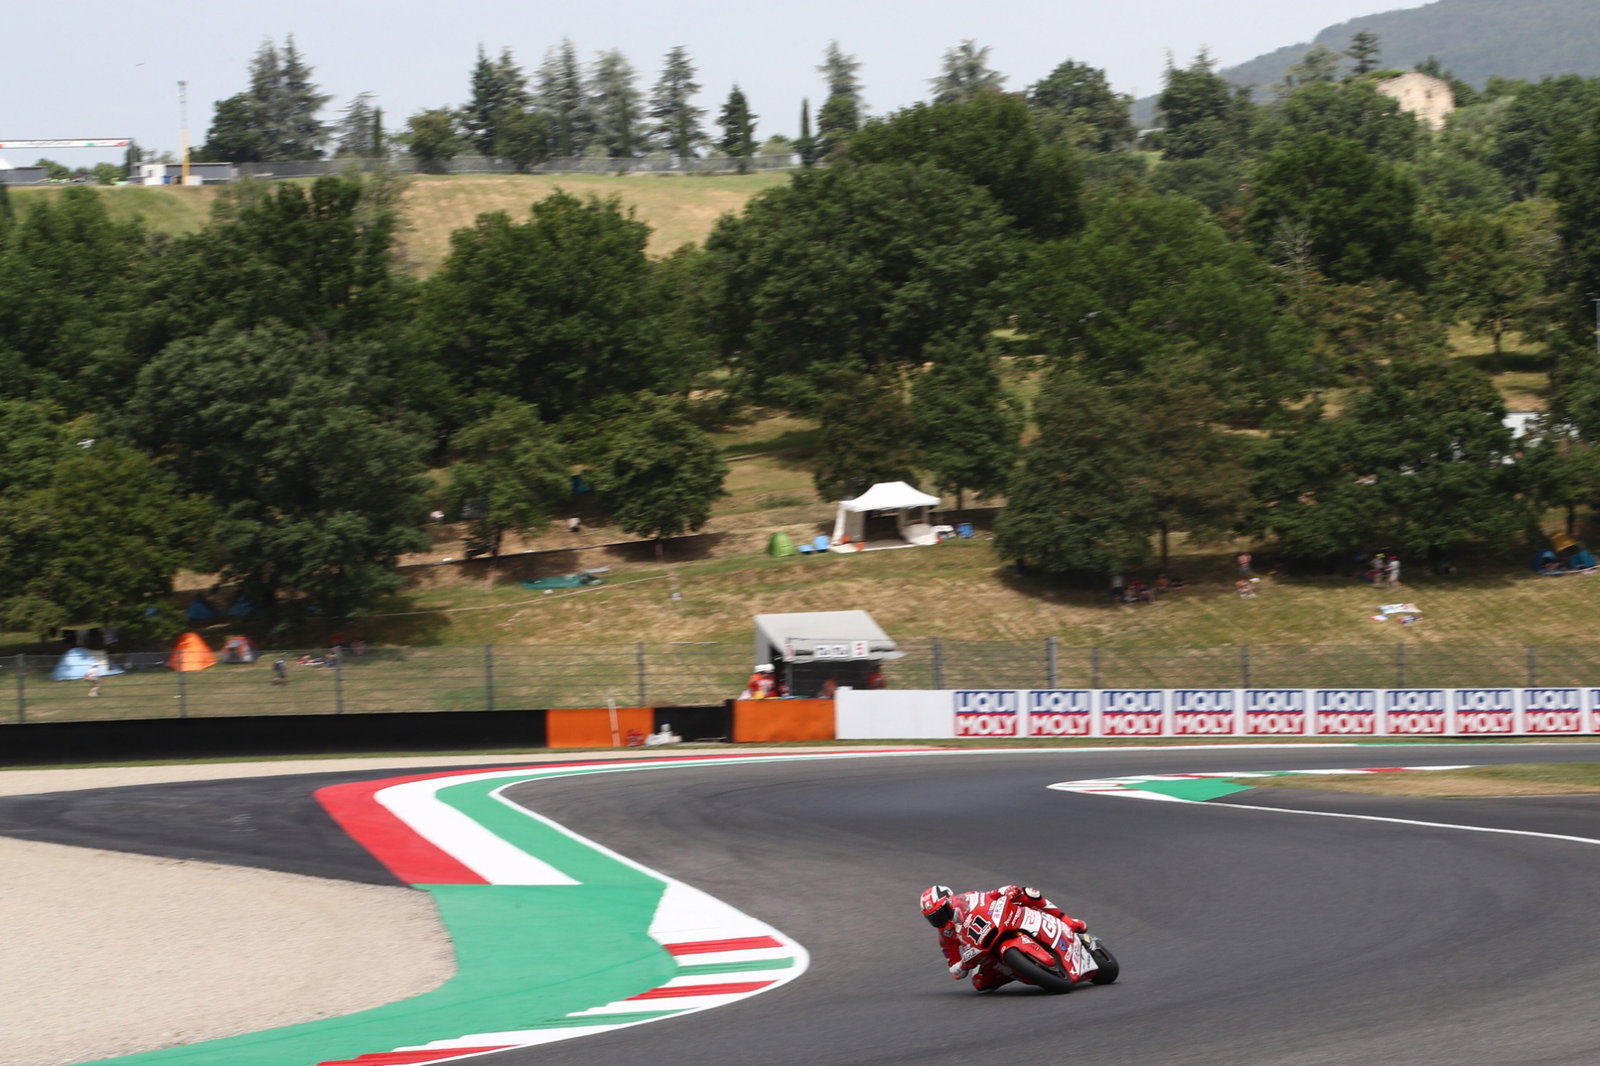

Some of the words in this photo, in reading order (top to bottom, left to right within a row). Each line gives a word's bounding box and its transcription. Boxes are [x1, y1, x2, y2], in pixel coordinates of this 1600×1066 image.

[956, 691, 1017, 712] LIQUI
[1030, 691, 1091, 712] LIQUI
[1102, 691, 1163, 711] LIQUI
[1174, 691, 1234, 711] LIQUI
[1246, 691, 1305, 711] LIQUI
[1317, 691, 1376, 711] LIQUI
[1387, 691, 1445, 711] LIQUI
[1457, 691, 1514, 711] LIQUI
[1525, 690, 1580, 710] LIQUI
[956, 713, 1017, 735] MOLY
[1030, 713, 1091, 735] MOLY
[1102, 713, 1163, 735] MOLY
[1174, 713, 1234, 734] MOLY
[1246, 713, 1305, 734] MOLY
[1317, 713, 1376, 734] MOLY
[1387, 712, 1445, 734] MOLY
[1457, 712, 1514, 733] MOLY
[1525, 712, 1580, 732] MOLY
[967, 915, 991, 945] 11
